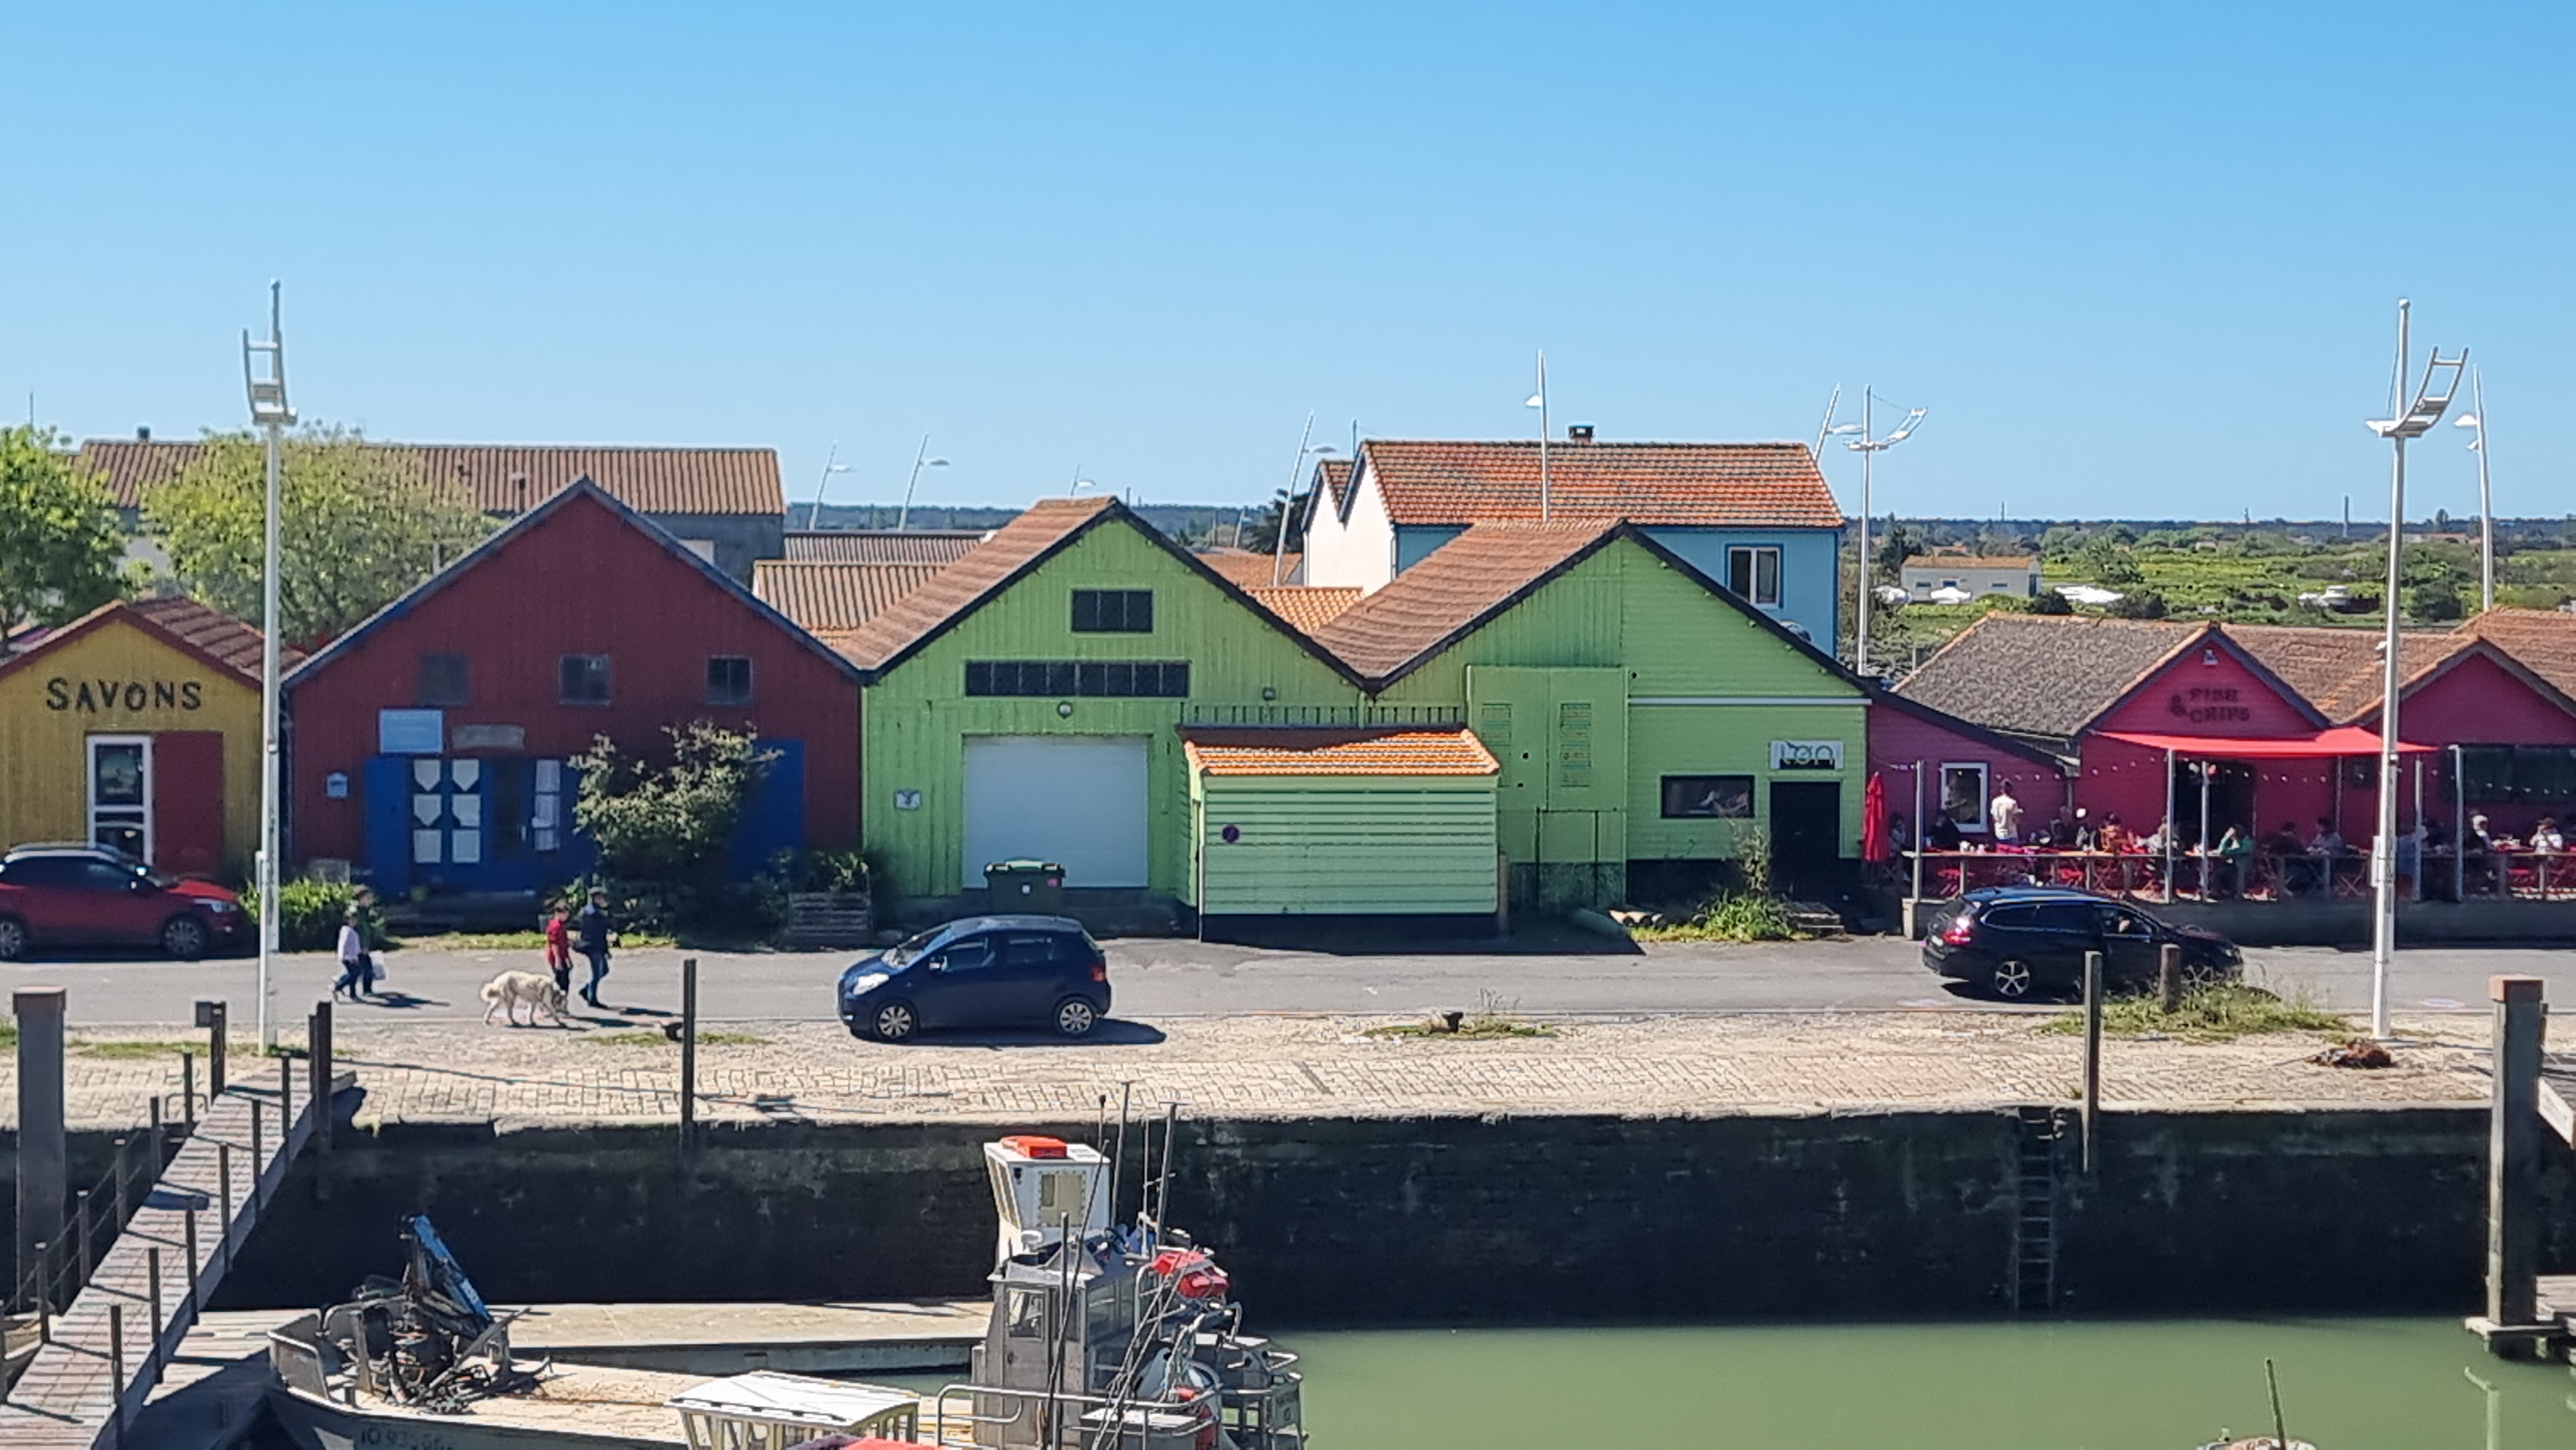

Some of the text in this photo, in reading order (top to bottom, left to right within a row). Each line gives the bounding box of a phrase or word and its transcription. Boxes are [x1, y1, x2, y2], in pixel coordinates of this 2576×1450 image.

[46, 677, 202, 713] SAVONS
[2190, 688, 2239, 702] FISH
[2190, 707, 2250, 722] CHIPS
